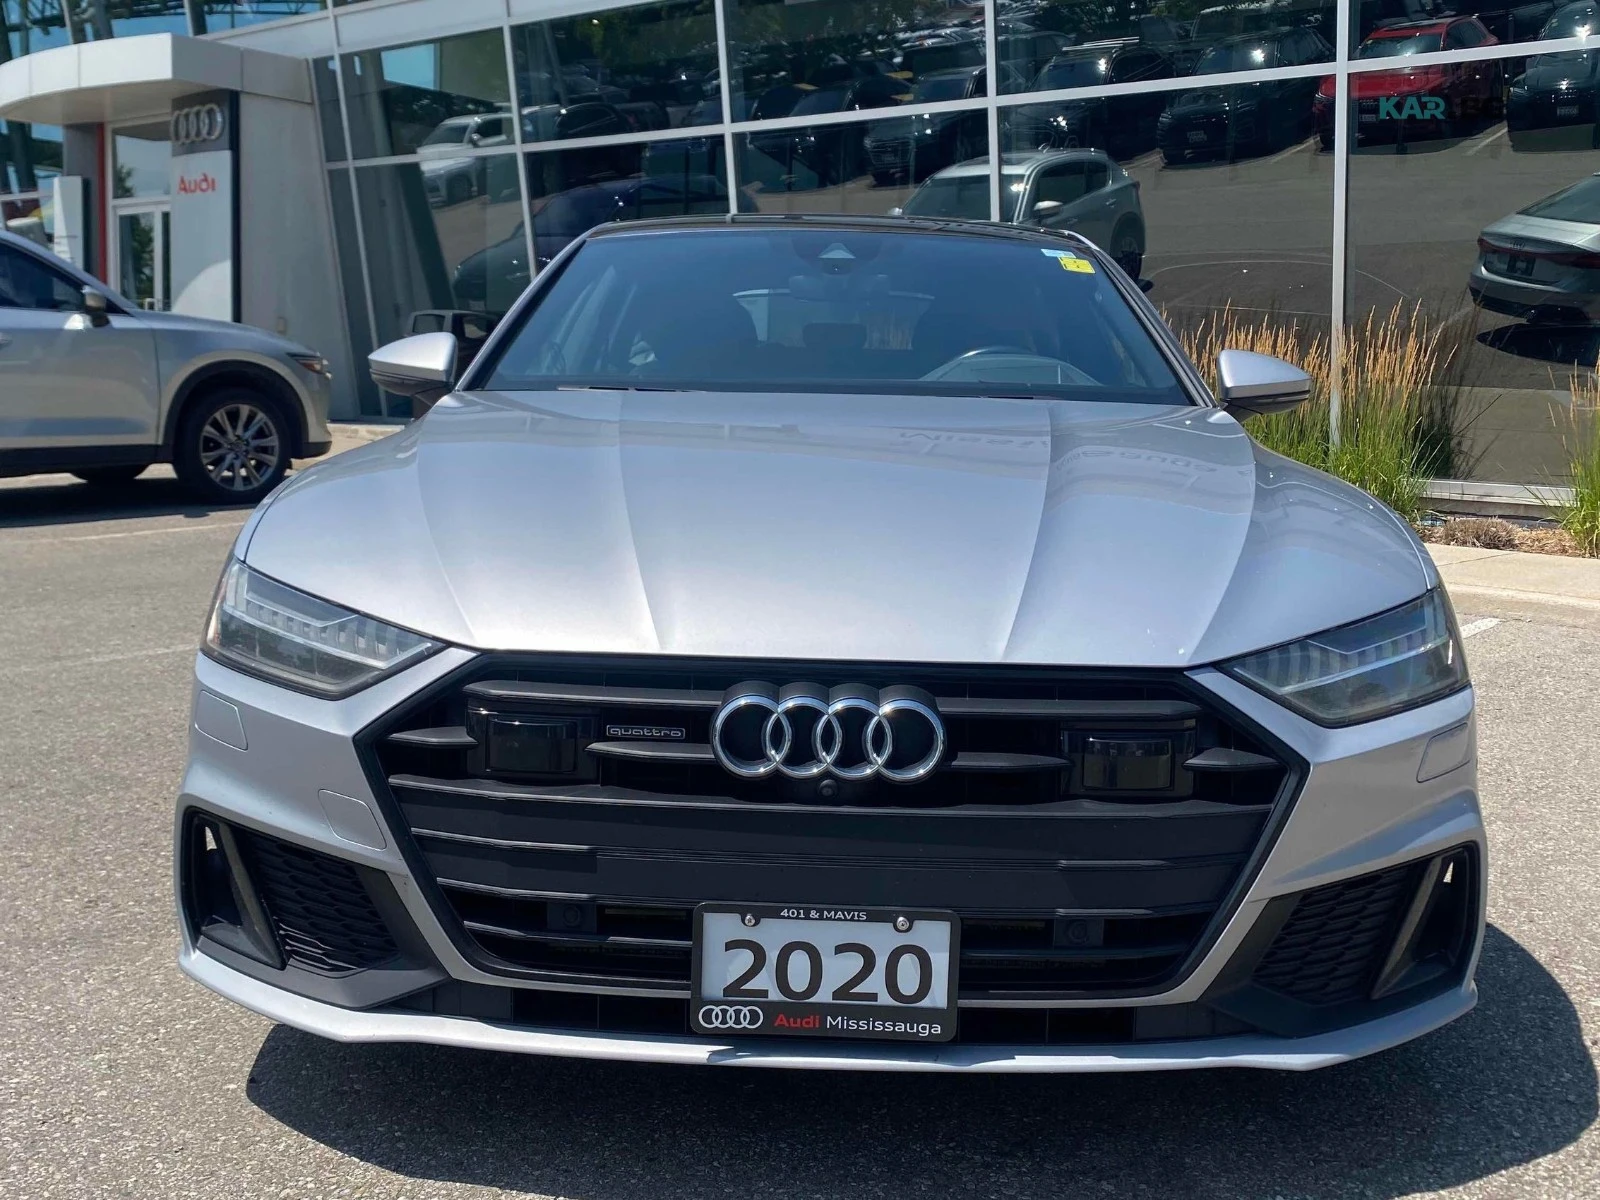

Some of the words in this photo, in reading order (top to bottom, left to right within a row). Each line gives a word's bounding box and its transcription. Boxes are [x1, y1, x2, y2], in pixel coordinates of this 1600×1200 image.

[177, 172, 217, 194] Audi
[610, 728, 682, 737] quattro
[780, 908, 806, 919] 401
[809, 909, 820, 919] &
[823, 910, 868, 921] MAVIS
[722, 938, 934, 1005] 2020
[774, 1013, 820, 1029] Audi
[826, 1015, 942, 1037] Mississauga
